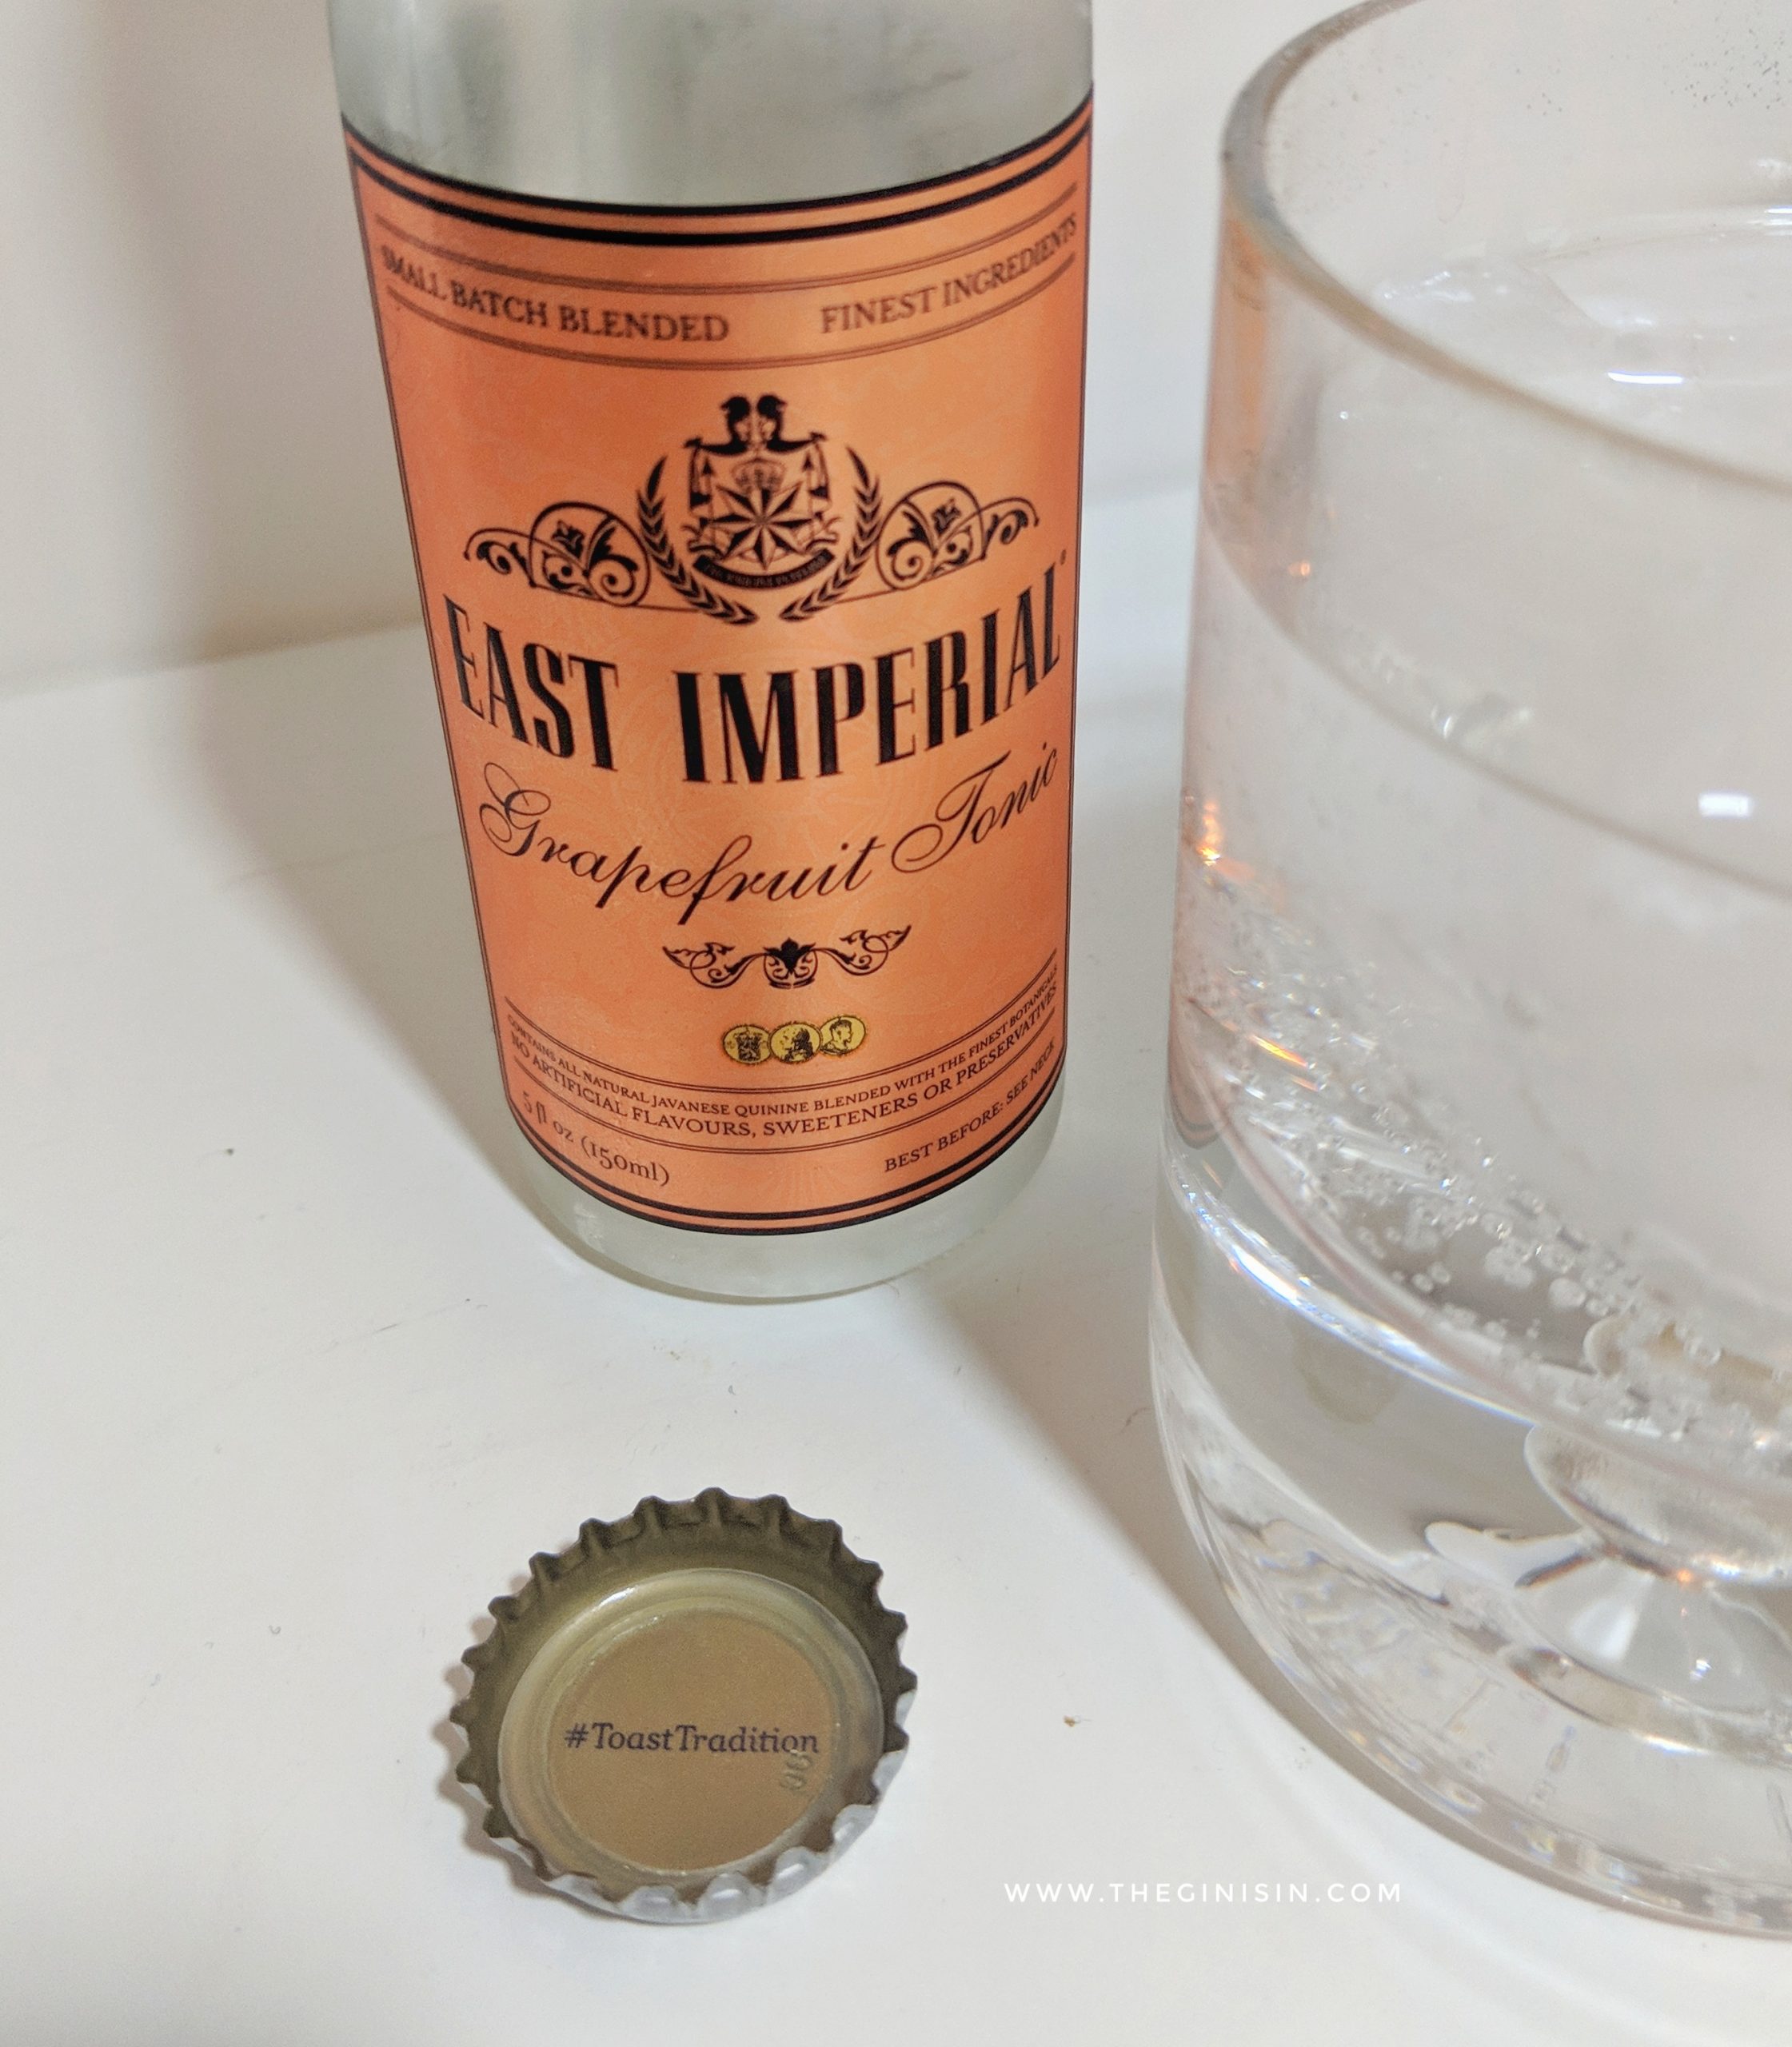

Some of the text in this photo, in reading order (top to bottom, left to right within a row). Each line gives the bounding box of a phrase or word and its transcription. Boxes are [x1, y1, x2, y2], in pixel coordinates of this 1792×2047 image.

[381, 243, 730, 342] SMALL BATCH BLENDED
[820, 212, 1078, 334] FINEST INGREDIENTS
[442, 560, 1062, 785] EAST IMPERIAL
[478, 738, 1059, 927] Grapefruit Tonic
[507, 963, 1057, 1117] CONTAINS ALL NATURAL JAVANESE QUININE BLENDED WITH THE FINEST BOTANICALS
[511, 980, 1057, 1139] NO ARTIFICIAL FLAVOURS, SWEETENERS OR PRESERVATIVES
[884, 1038, 1056, 1174] BEST BEFORE: SEE NECK
[522, 1091, 671, 1187] 5 fl oz (150ml)
[563, 1721, 820, 1754] #ToastTradition
